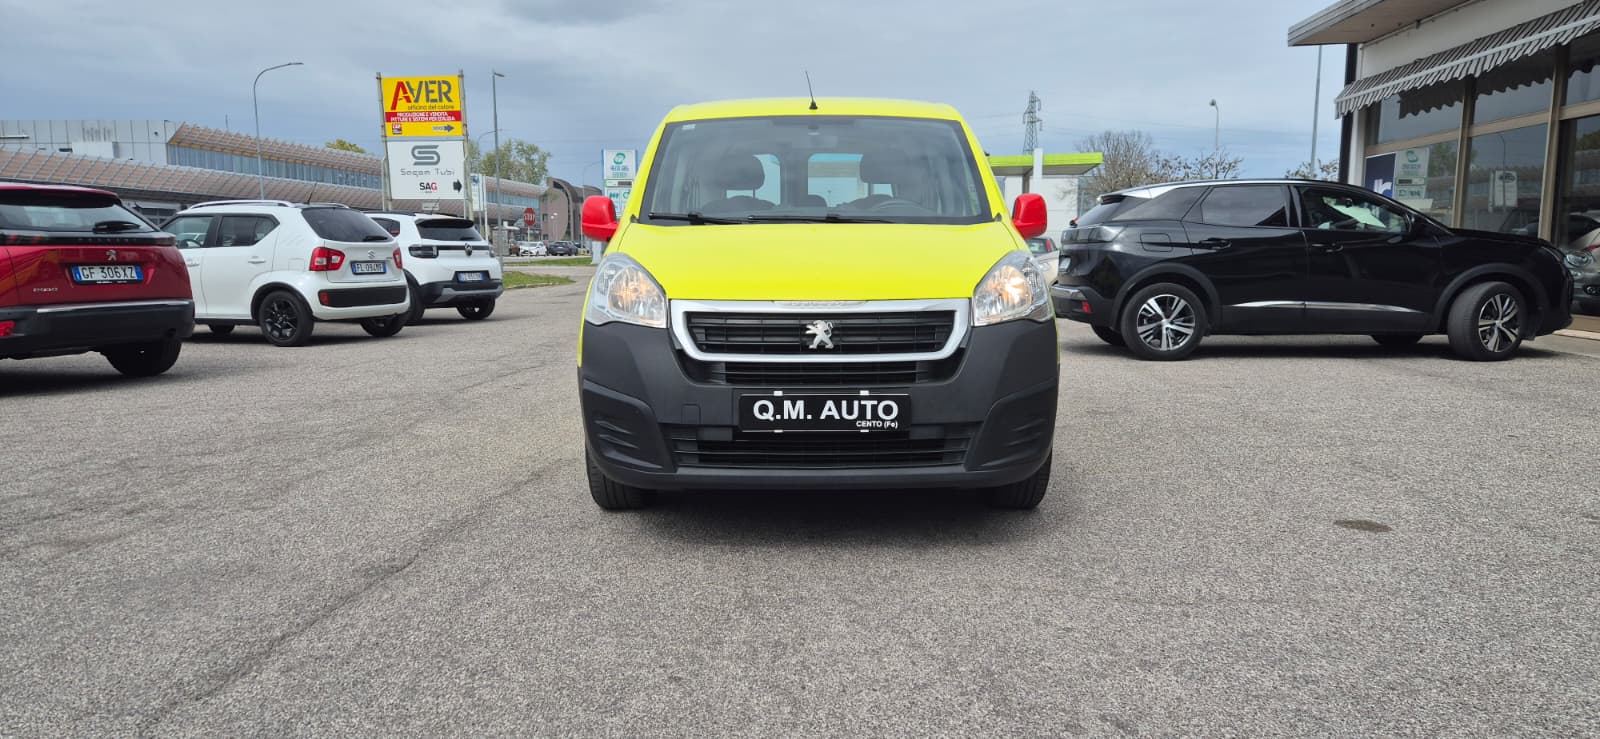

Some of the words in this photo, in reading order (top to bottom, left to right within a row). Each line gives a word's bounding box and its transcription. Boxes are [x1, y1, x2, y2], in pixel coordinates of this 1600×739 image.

[391, 80, 453, 110] AVER
[81, 267, 96, 279] GF
[100, 266, 135, 278] 306XZ
[753, 400, 812, 421] Q.M.
[820, 400, 899, 420] AUTO
[856, 420, 882, 428] CENTO
